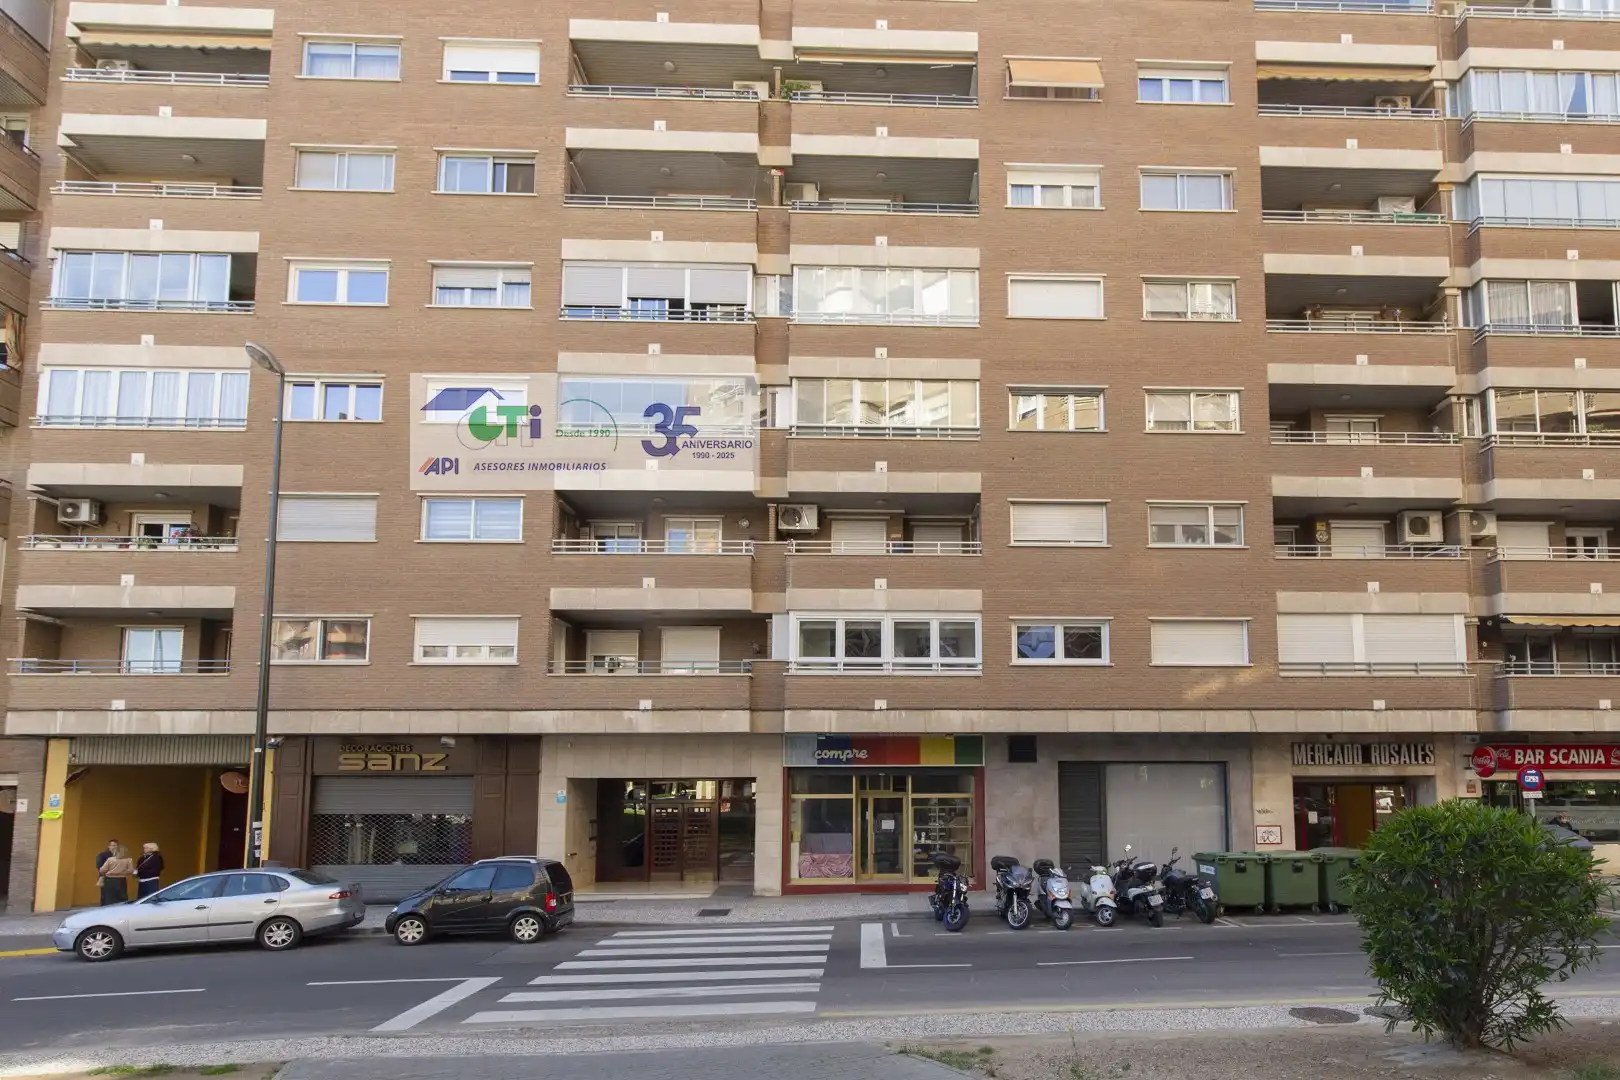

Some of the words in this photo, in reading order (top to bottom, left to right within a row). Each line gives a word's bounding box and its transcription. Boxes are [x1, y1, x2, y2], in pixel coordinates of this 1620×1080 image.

[338, 744, 412, 752] DECORACIONES
[814, 749, 868, 761] compre
[1293, 743, 1363, 765] MERCADO
[1370, 743, 1435, 765] ROSALES
[1514, 748, 1545, 765] BAR
[1549, 748, 1606, 765] SCANIA
